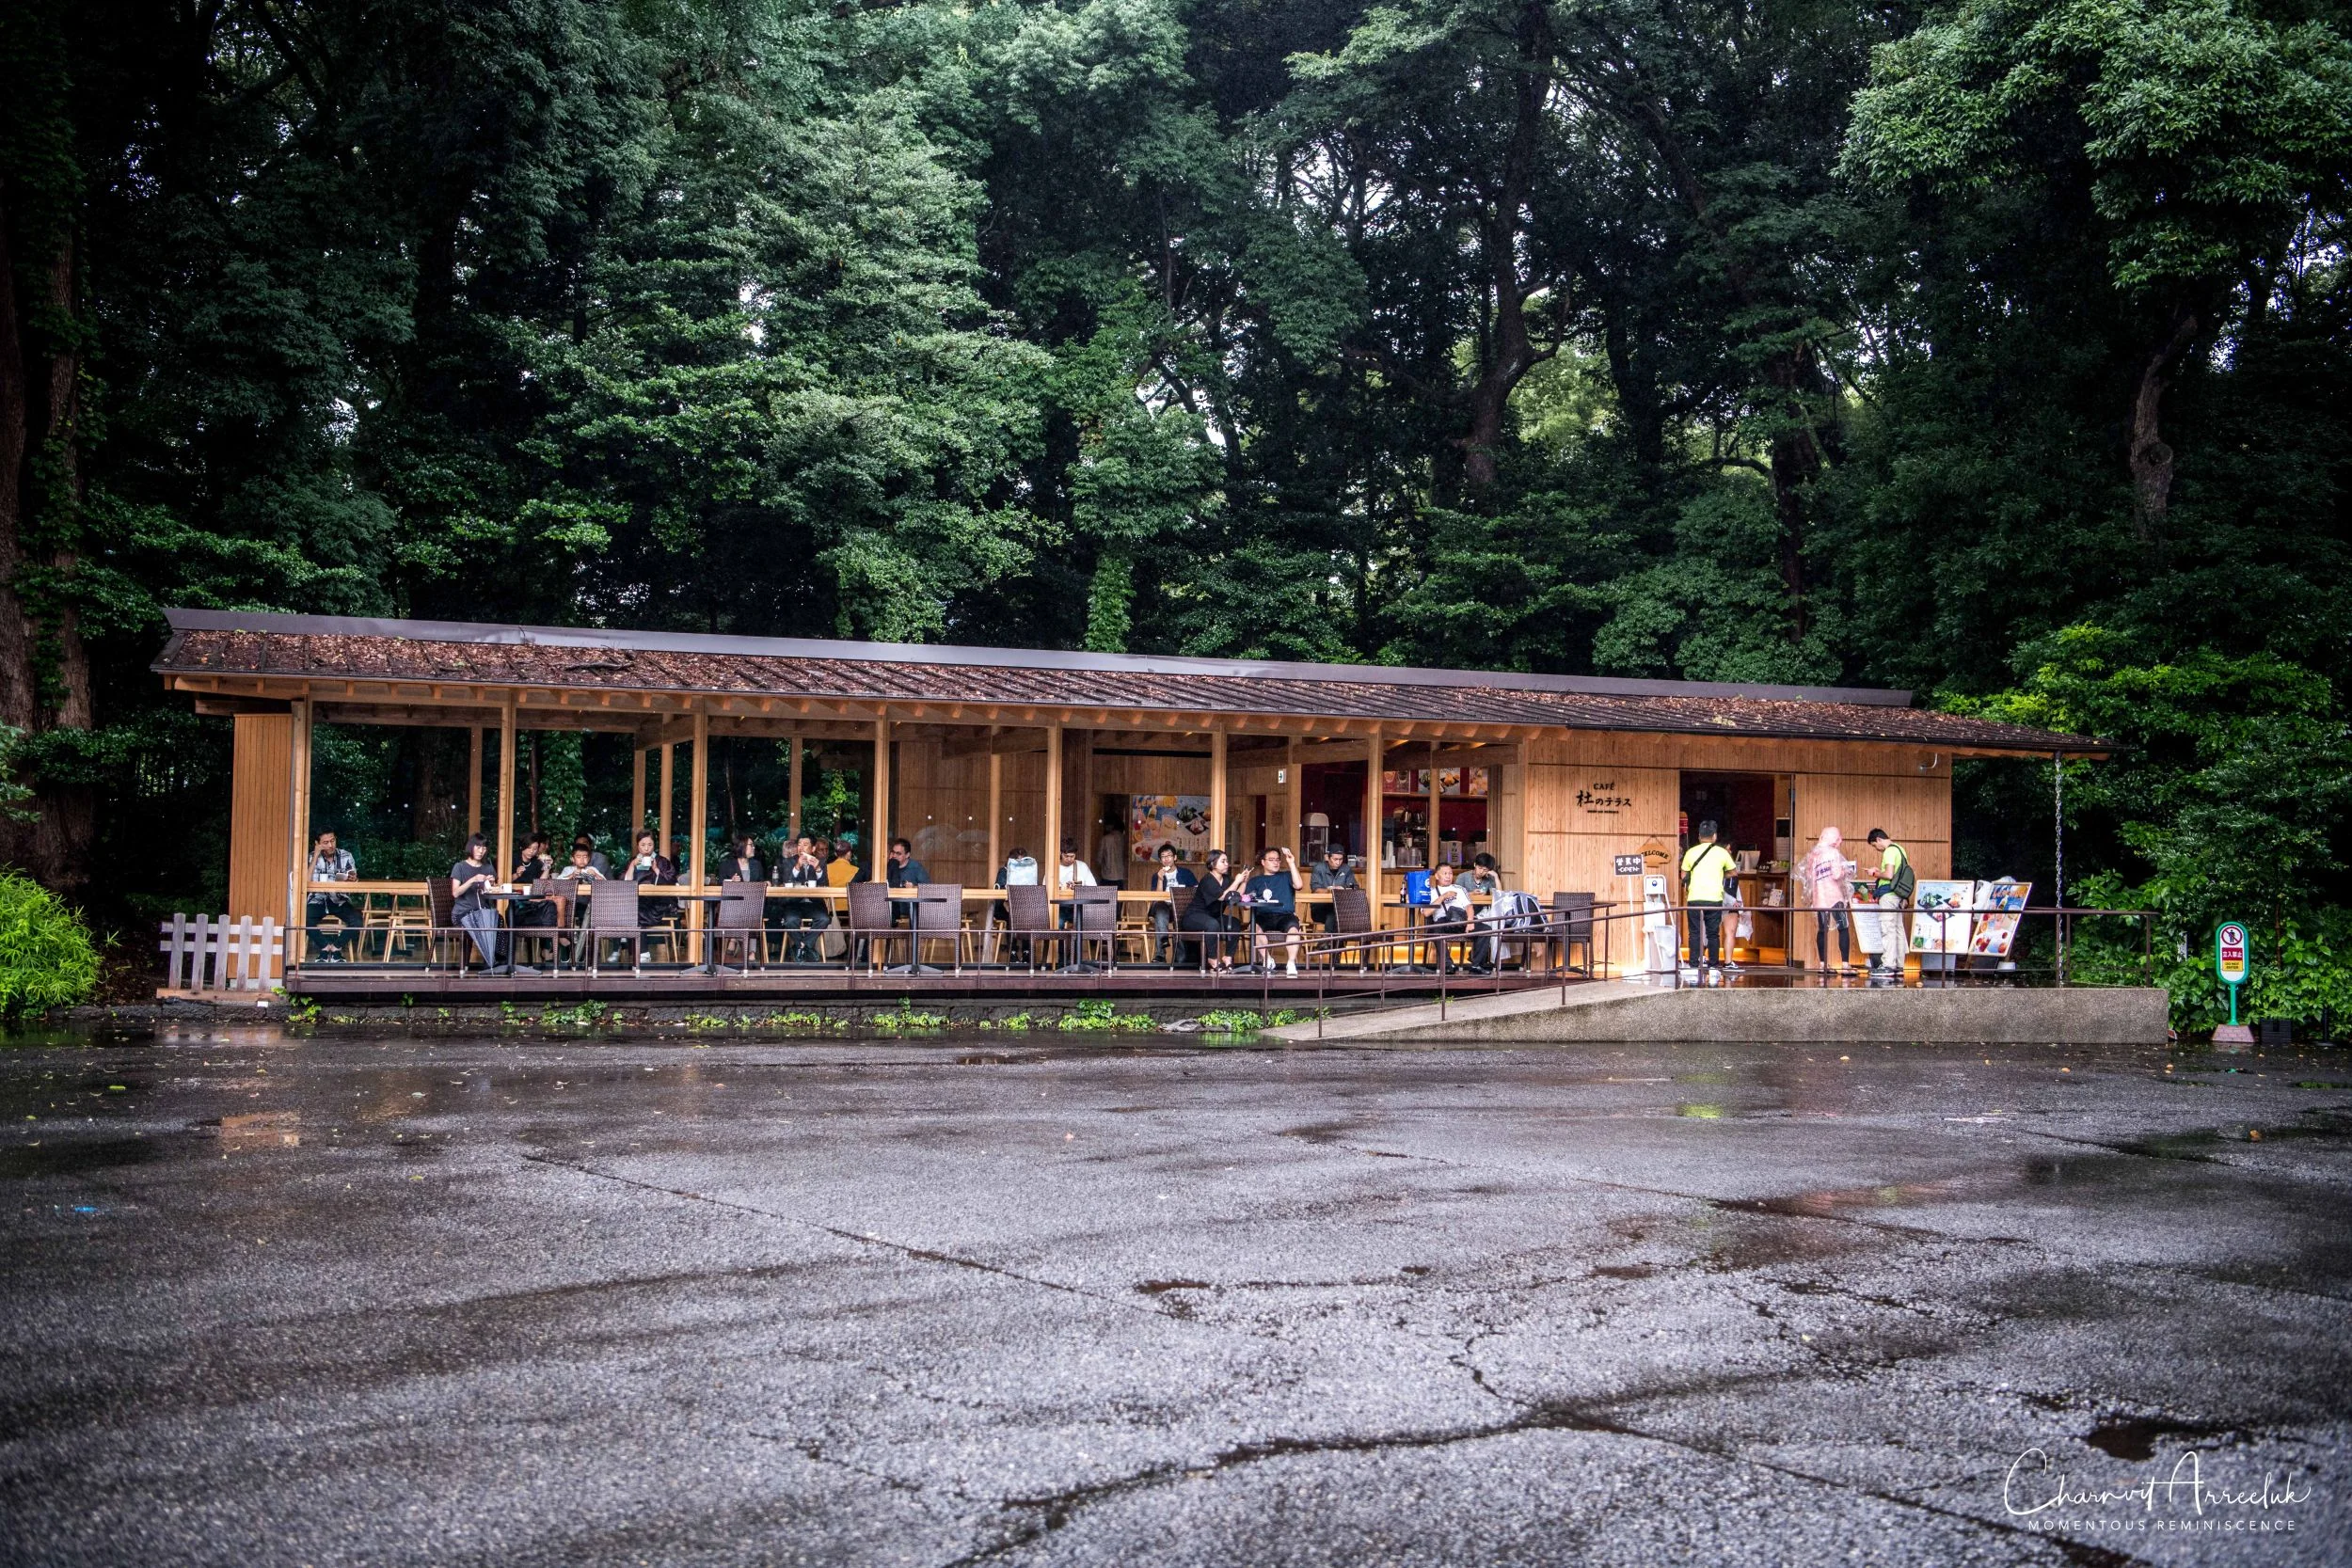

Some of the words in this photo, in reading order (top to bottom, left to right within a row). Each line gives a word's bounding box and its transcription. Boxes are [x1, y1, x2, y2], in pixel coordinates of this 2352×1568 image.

[1593, 782, 1615, 791] CAFÉ
[1576, 790, 1631, 807] 杜のテラス
[1615, 857, 1642, 866] 営業中
